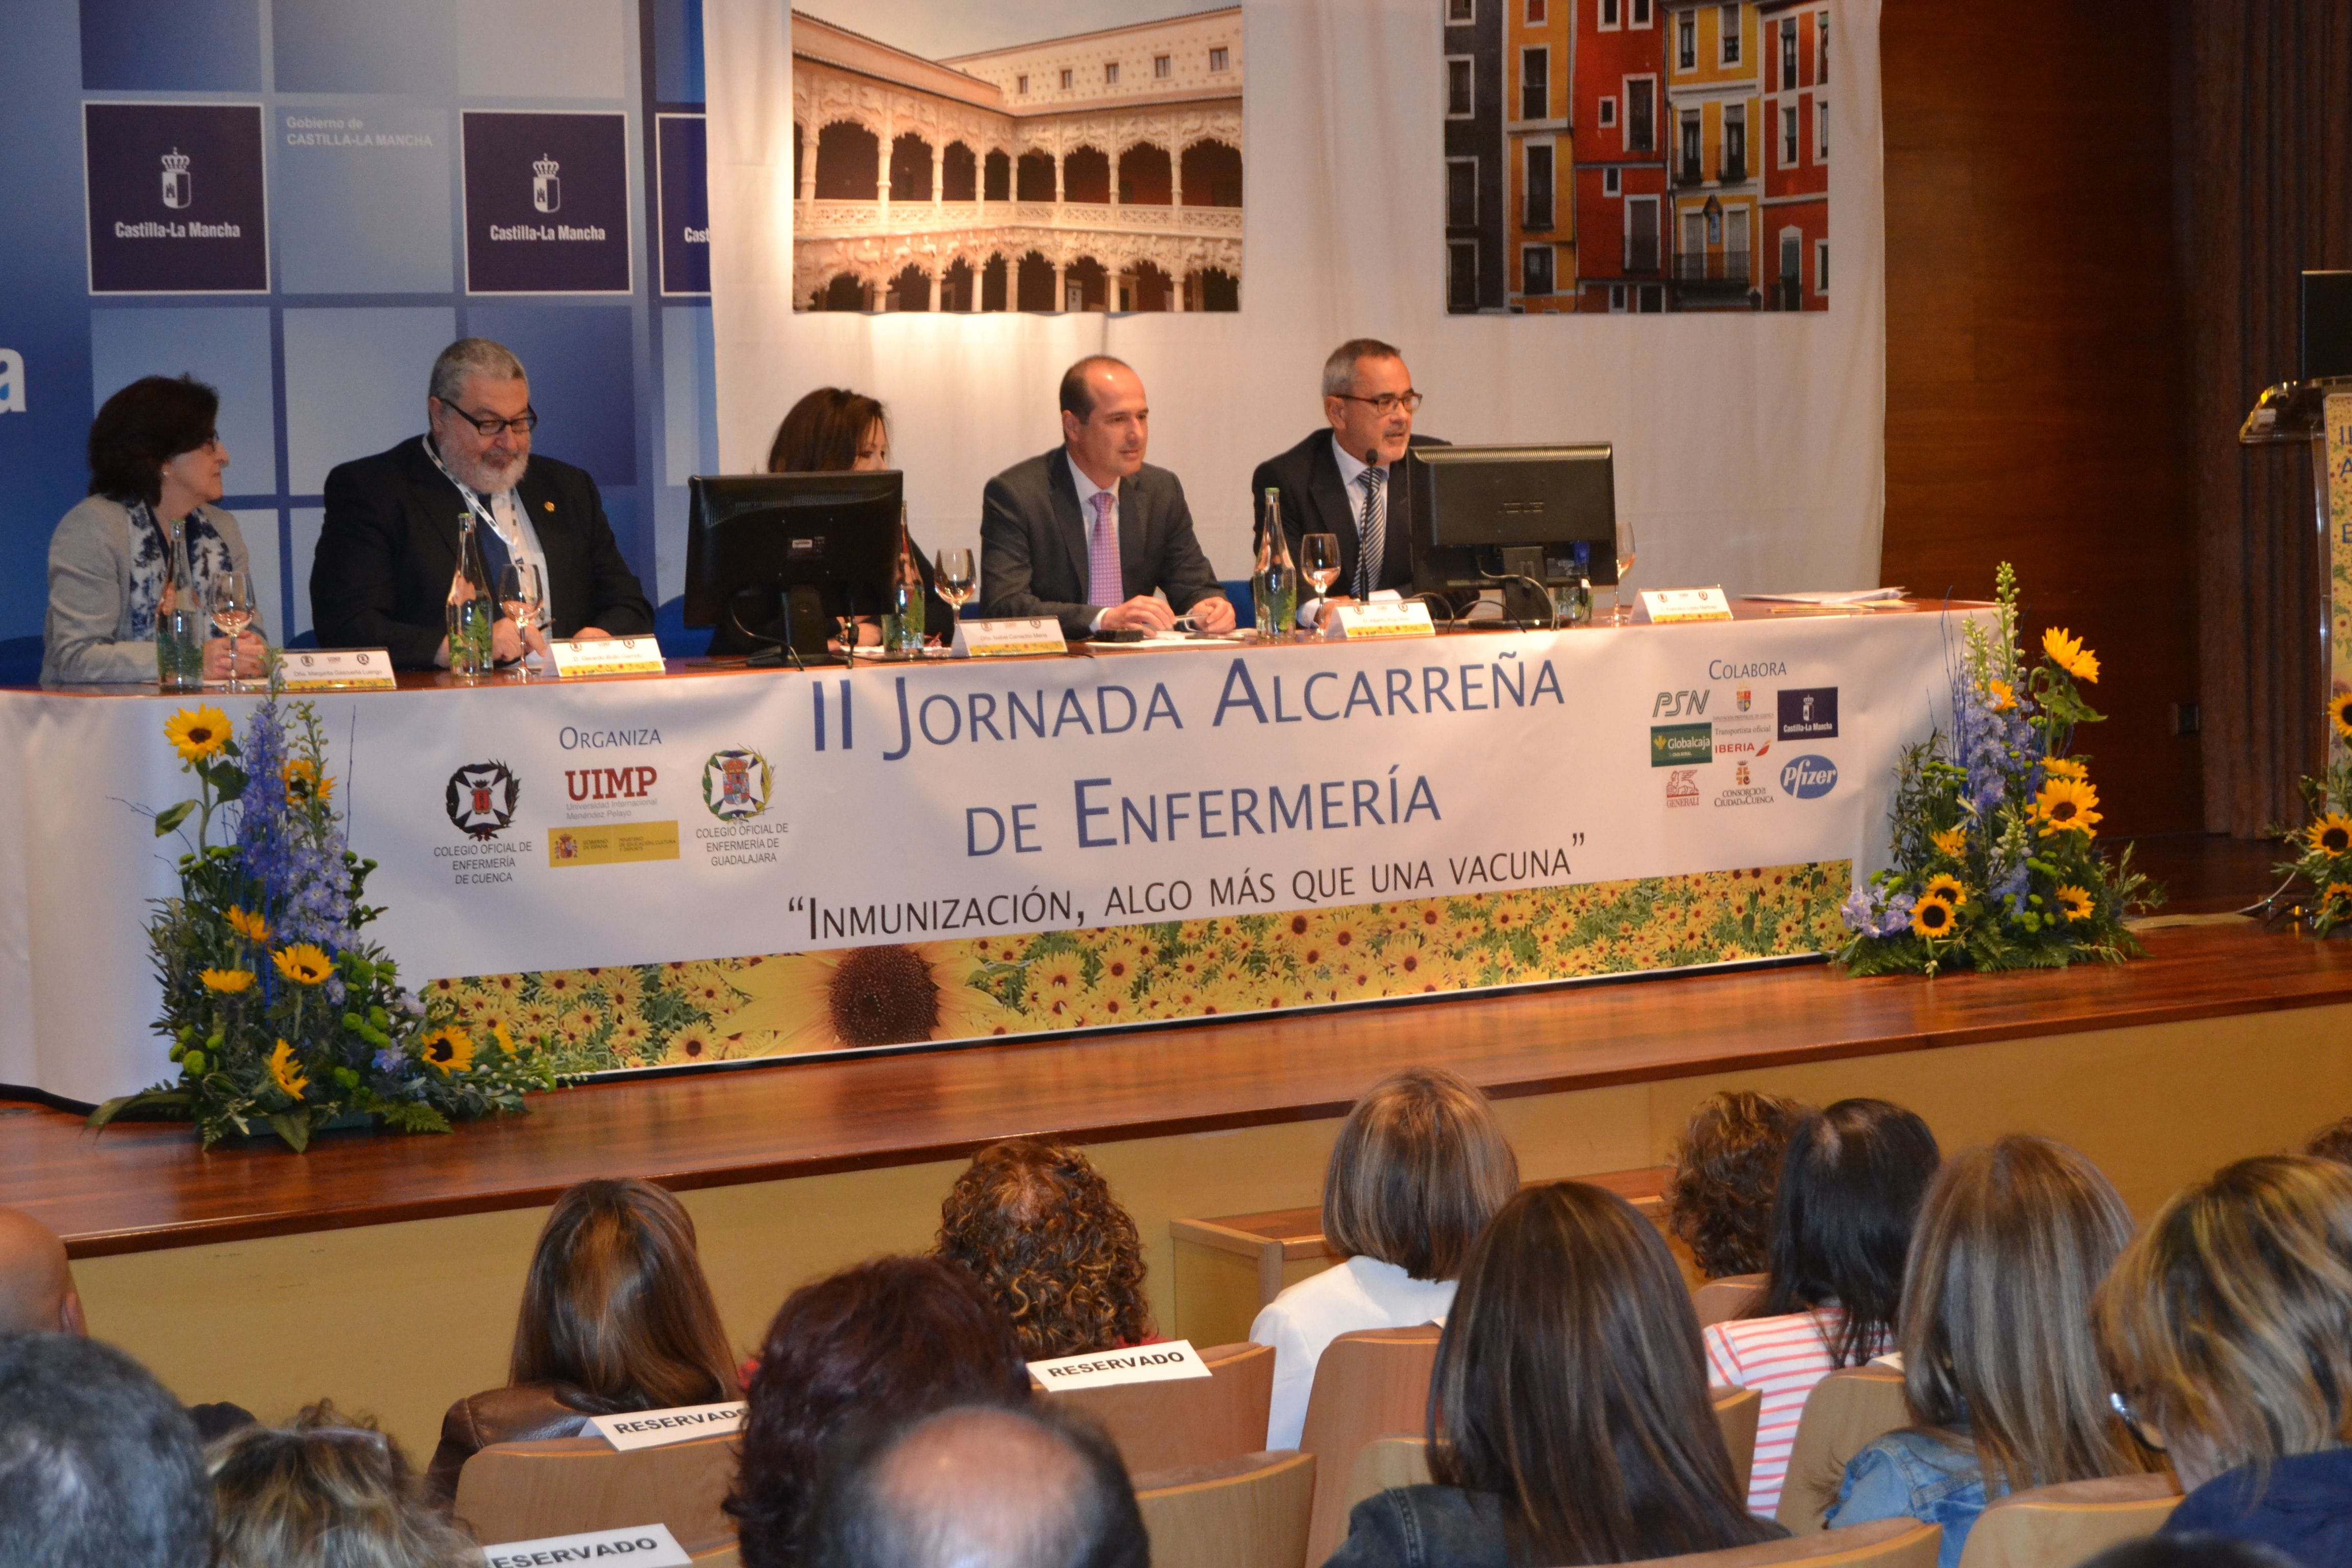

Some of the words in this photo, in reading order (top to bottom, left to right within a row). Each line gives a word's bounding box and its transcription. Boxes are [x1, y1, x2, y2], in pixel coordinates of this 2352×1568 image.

[286, 116, 345, 129] Gobierno
[348, 117, 363, 129] de
[287, 133, 373, 146] CASTILLA-LA
[375, 134, 433, 147] MANCHA
[115, 222, 186, 238] Castilla-La
[189, 222, 240, 238] Mancha
[490, 225, 555, 241] Castilla-La
[558, 226, 606, 241] Mancha
[1709, 659, 1786, 679] COLABORA
[813, 679, 852, 751] II
[883, 677, 1184, 761] JORNADA
[1212, 651, 1565, 727] ALCARREÑA
[1652, 690, 1710, 718] PSN
[1715, 727, 1751, 737] Transportista
[1753, 725, 1771, 733] oficial
[1783, 724, 1812, 732] Castilla-La
[1813, 722, 1832, 731] Mancha
[559, 727, 662, 750] ORGANIZA
[1668, 736, 1710, 750] Globalcaja
[1715, 743, 1755, 753] IBERIA
[565, 766, 657, 801] UIMP
[1783, 759, 1836, 798] Pfizer
[1722, 787, 1761, 797] CONSORCIO
[566, 802, 609, 811] Universidad
[611, 798, 657, 807] Internacional
[1667, 797, 1699, 808] GENERALI
[1714, 797, 1742, 807] CIUDAD
[1746, 795, 1774, 804] CUENCA
[566, 811, 605, 820] Menéndez
[607, 810, 631, 819] Pelayo
[966, 803, 1042, 856] DE
[1074, 764, 1442, 848] ENFERMERÍA
[696, 826, 737, 838] COLEGIO
[739, 824, 774, 836] OFICIAL
[776, 823, 789, 833] DE
[434, 845, 478, 856] COLEGIO
[480, 843, 517, 854] OFICIAL
[519, 841, 532, 851] DE
[706, 837, 765, 852] ENFERMERÍA
[767, 838, 779, 848] DE
[452, 855, 516, 870] ENFERMERÍA
[711, 852, 777, 866] GUADALAJARA
[455, 874, 469, 884] DE
[472, 872, 513, 884] CUENCA
[1104, 880, 1192, 917] ALGO
[1210, 868, 1276, 907] MÁS
[1292, 867, 1356, 903] QUE
[1371, 861, 1434, 893] UNA
[1047, 1352, 1185, 1377] RESERVADO
[488, 1537, 657, 1568] ESERVADO
